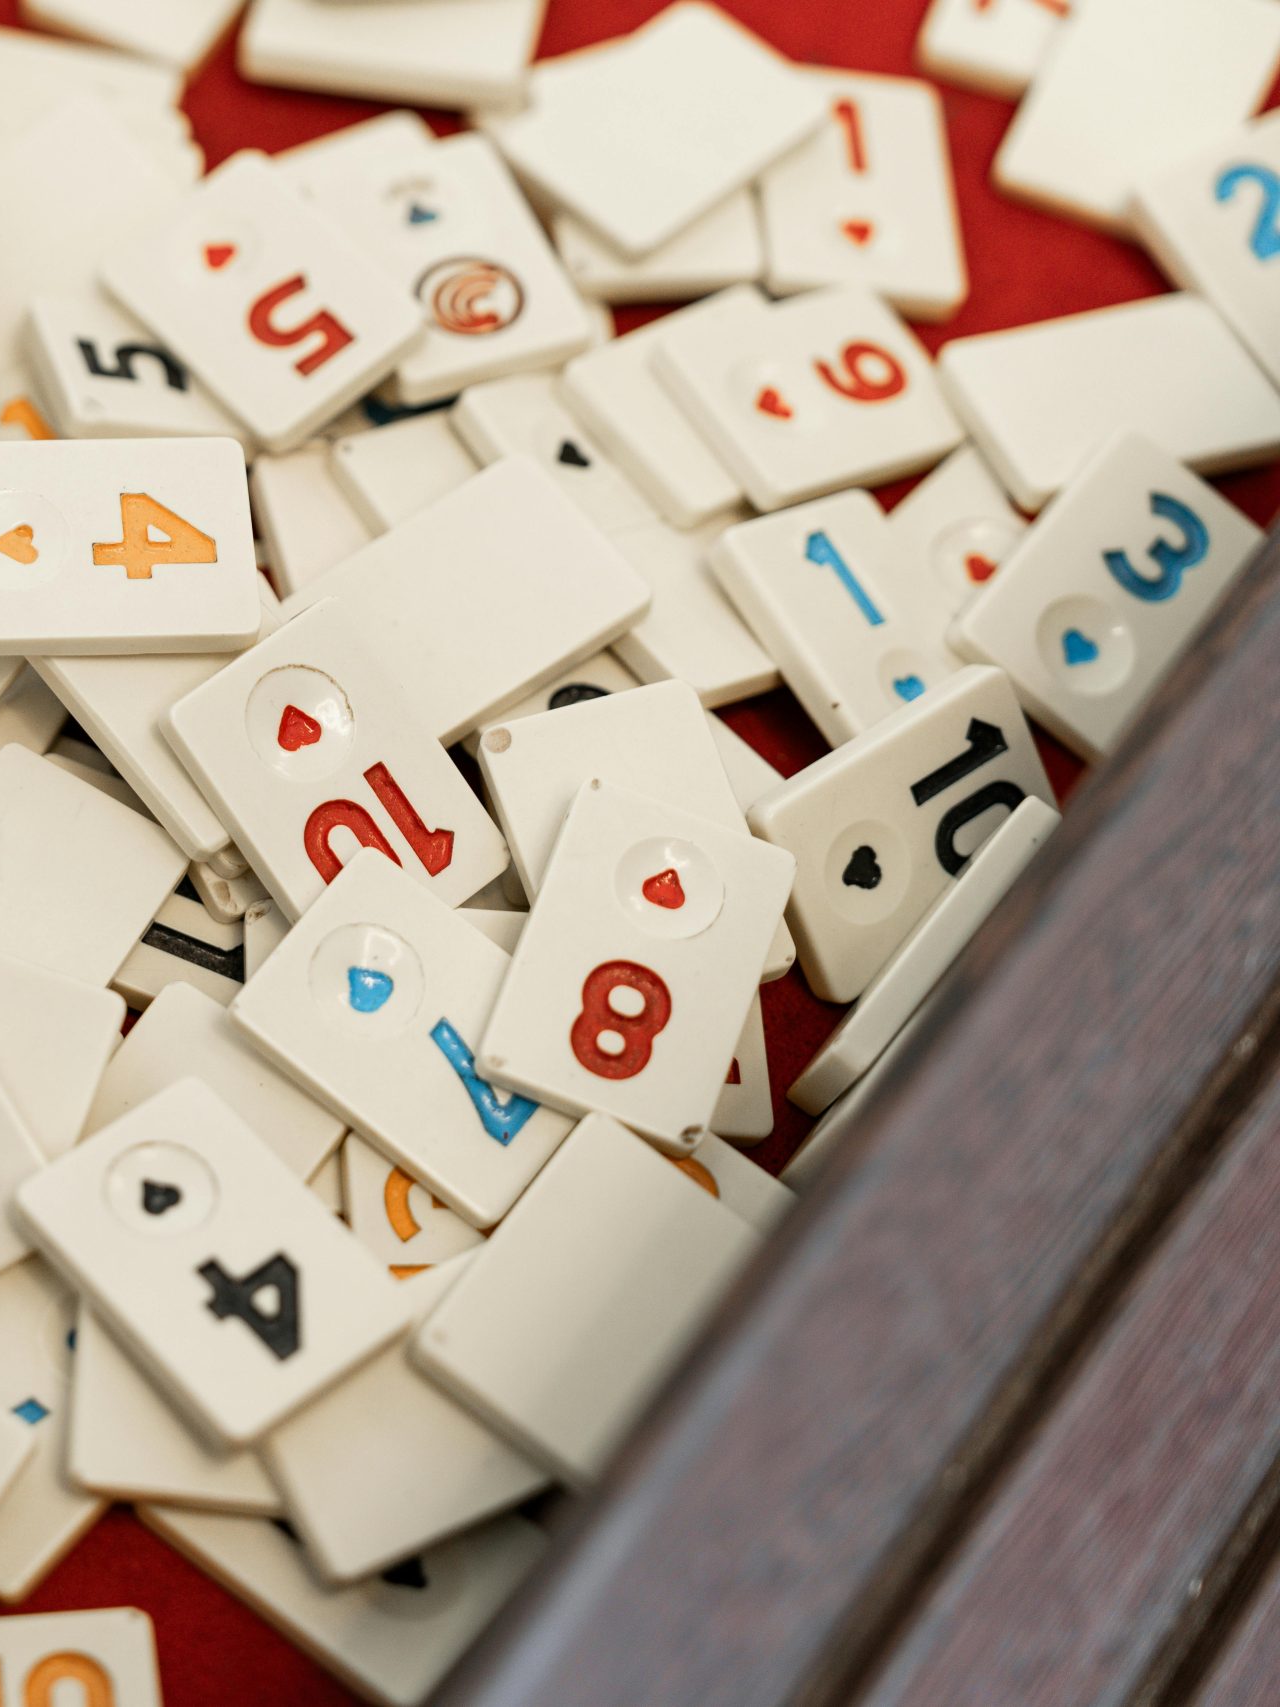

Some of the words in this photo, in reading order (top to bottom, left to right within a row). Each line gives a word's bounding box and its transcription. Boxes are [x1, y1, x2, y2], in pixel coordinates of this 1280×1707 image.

[246, 272, 356, 379] 5
[91, 492, 220, 581] 4
[804, 529, 887, 627] 1
[1100, 490, 1211, 605] 3
[302, 760, 457, 886] 10
[909, 717, 1030, 879] 10
[568, 957, 674, 1083] 8
[429, 1015, 541, 1148] 7
[194, 1250, 303, 1363] 4
